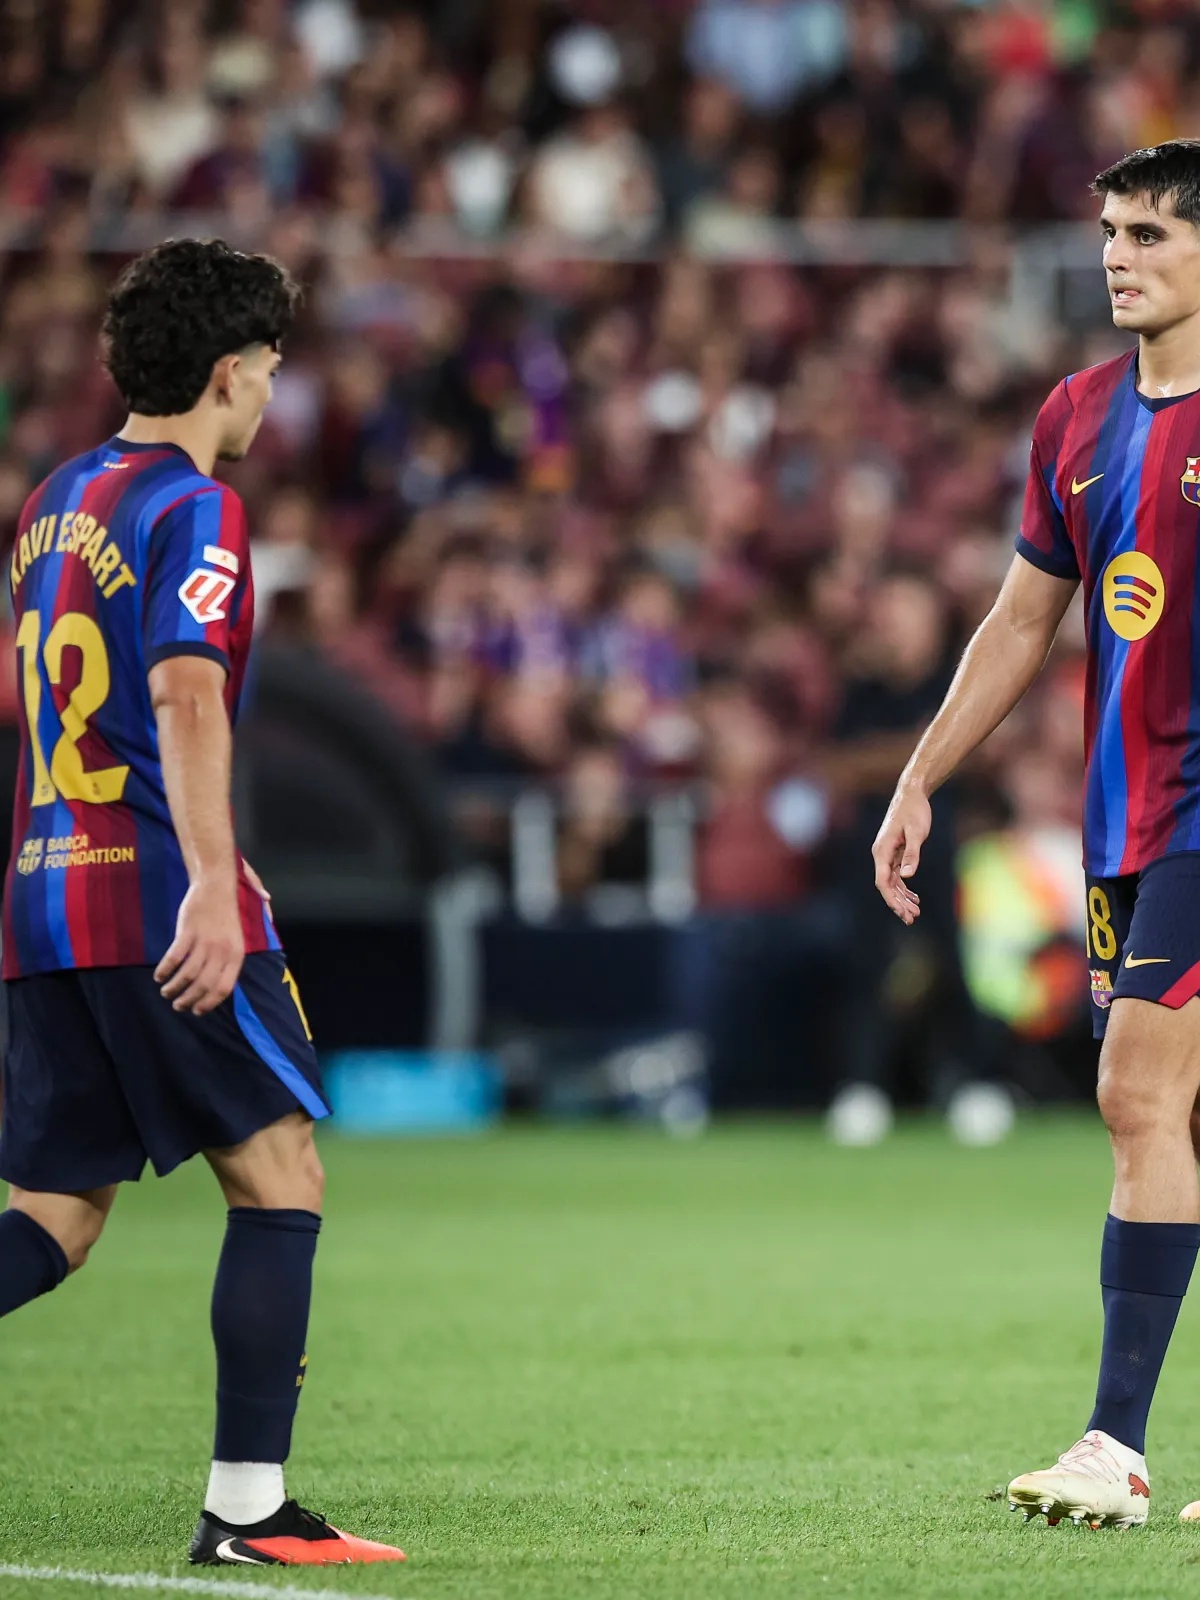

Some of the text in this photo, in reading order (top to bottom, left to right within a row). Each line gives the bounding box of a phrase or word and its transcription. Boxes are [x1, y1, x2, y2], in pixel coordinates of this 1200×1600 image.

[56, 512, 137, 599] ESPART
[15, 609, 131, 807] 12
[44, 847, 135, 870] FOUNDATION
